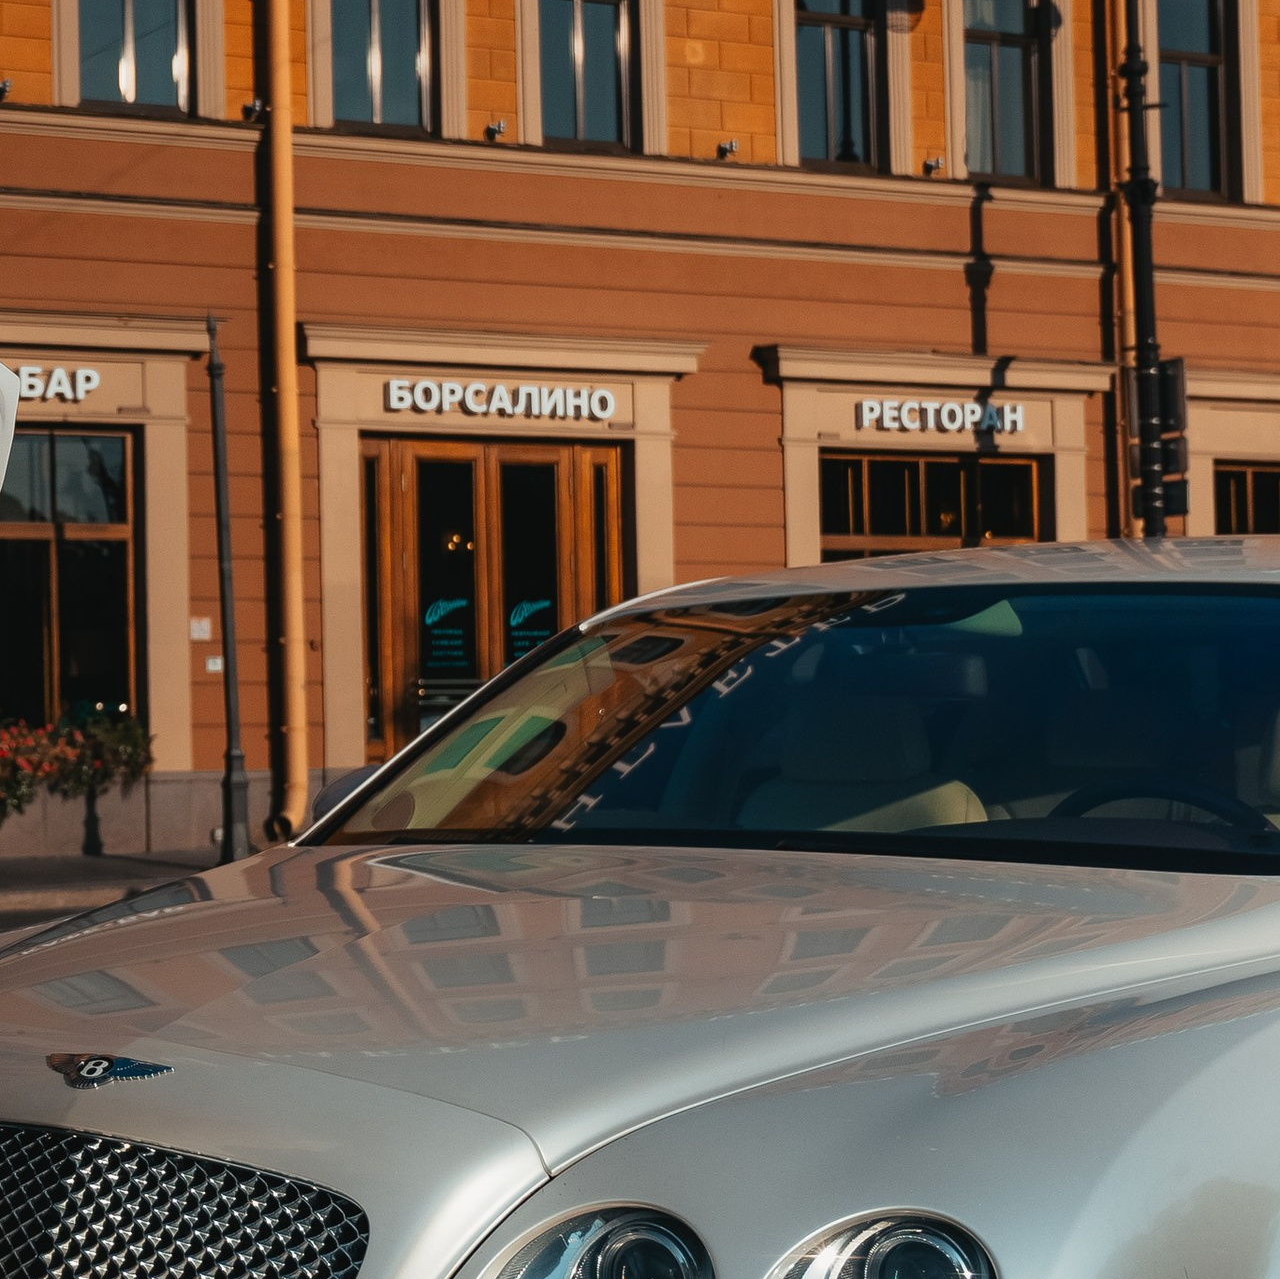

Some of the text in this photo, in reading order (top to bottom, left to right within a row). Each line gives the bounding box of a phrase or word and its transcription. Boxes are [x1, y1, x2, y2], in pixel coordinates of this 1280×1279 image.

[19, 366, 100, 400] БАР
[389, 379, 616, 419] БОРСАЛИНО
[862, 400, 1024, 431] РЕСТОРАН
